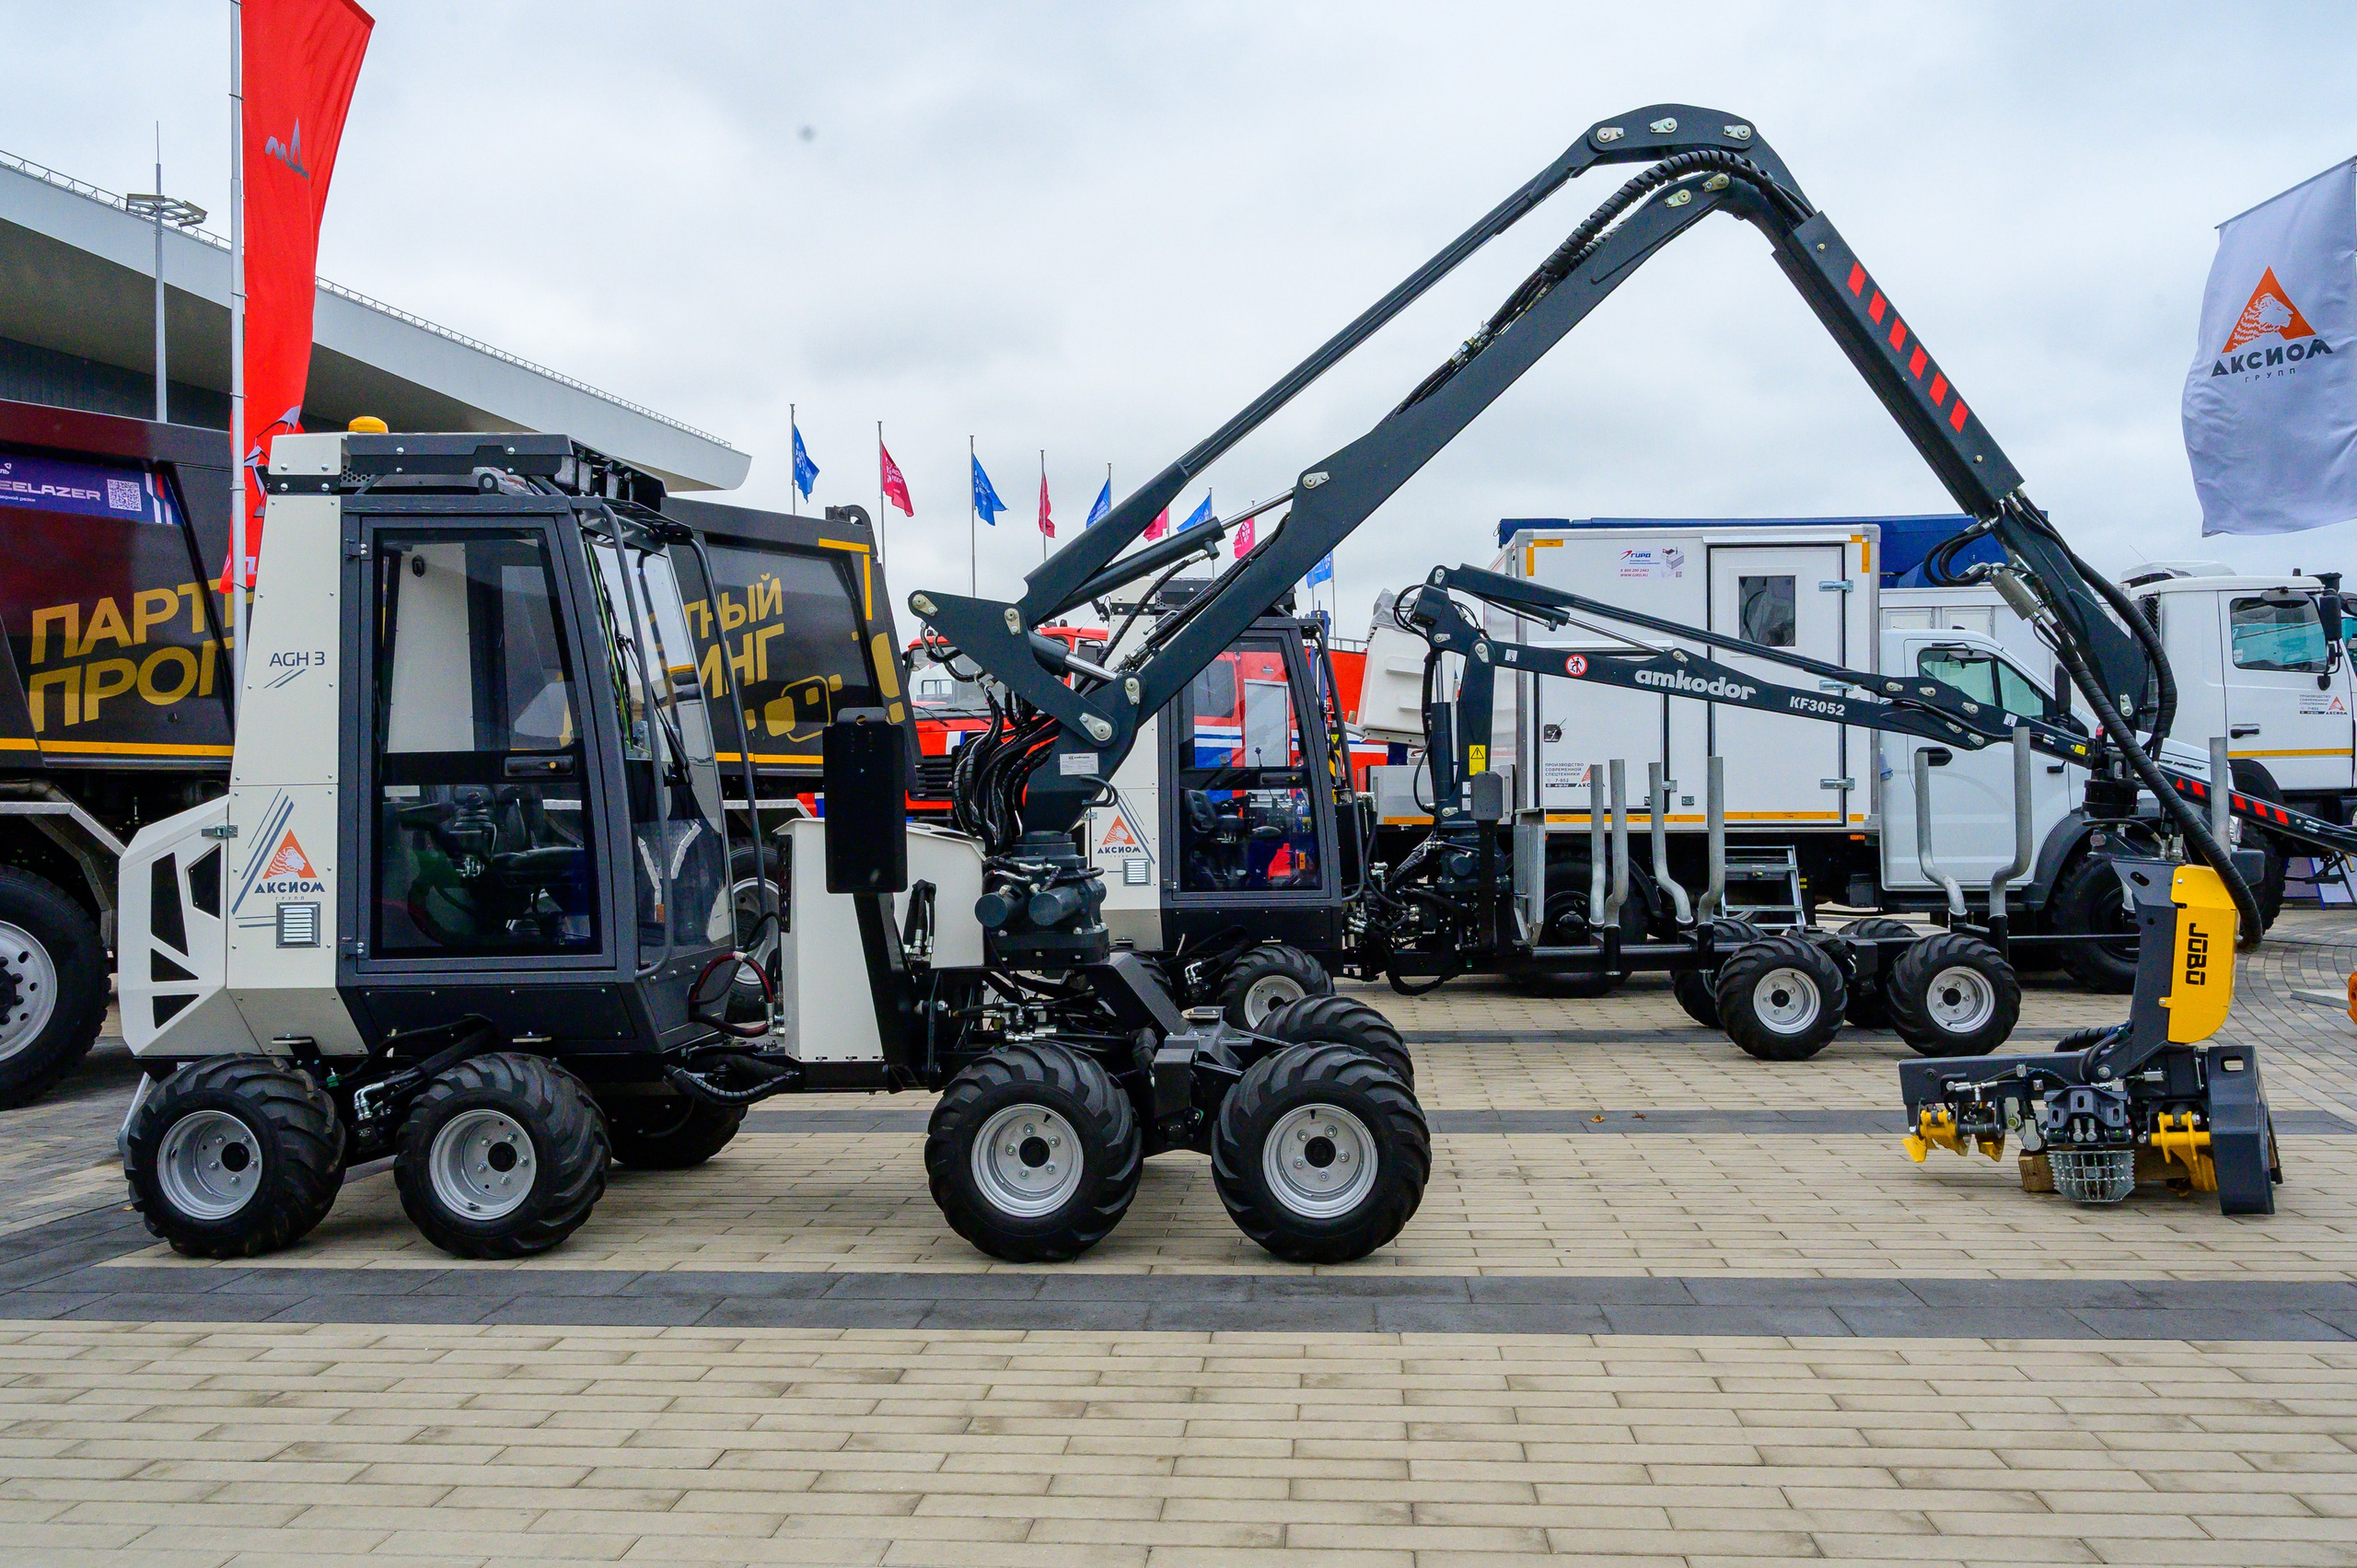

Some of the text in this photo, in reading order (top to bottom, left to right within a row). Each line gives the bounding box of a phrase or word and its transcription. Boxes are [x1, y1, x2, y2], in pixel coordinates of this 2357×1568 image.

[2211, 337, 2334, 377] АКСИОМ
[2245, 367, 2296, 383] ГРУПП
[269, 651, 326, 668] AGH 3
[1634, 668, 1757, 701] amkodor
[1789, 695, 1846, 716] KF3052
[1097, 846, 1142, 854] АКСИОМ
[254, 880, 326, 894] АКСИОМ
